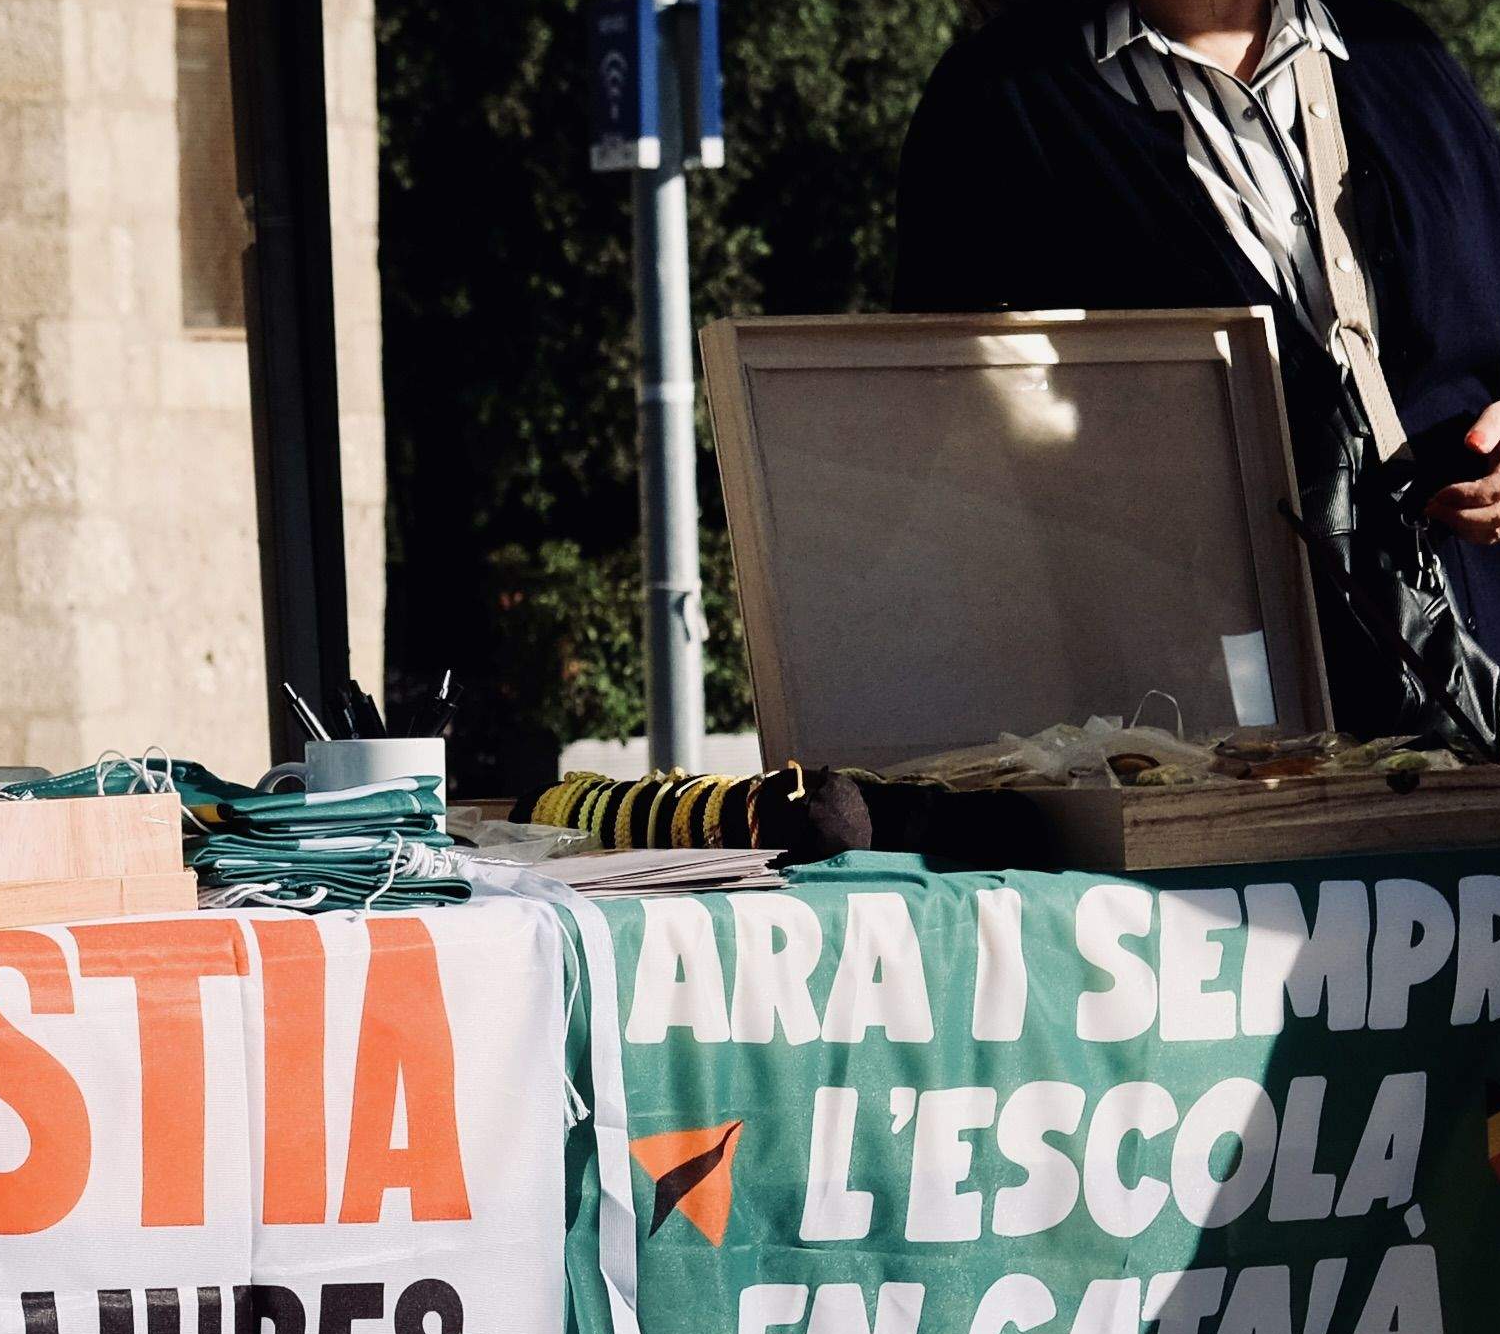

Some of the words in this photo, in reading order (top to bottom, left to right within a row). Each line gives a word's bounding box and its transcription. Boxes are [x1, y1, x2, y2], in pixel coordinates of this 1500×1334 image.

[625, 891, 933, 1044] ARA
[972, 886, 1028, 1042] I
[798, 1069, 1428, 1244] L'ESCOLA
